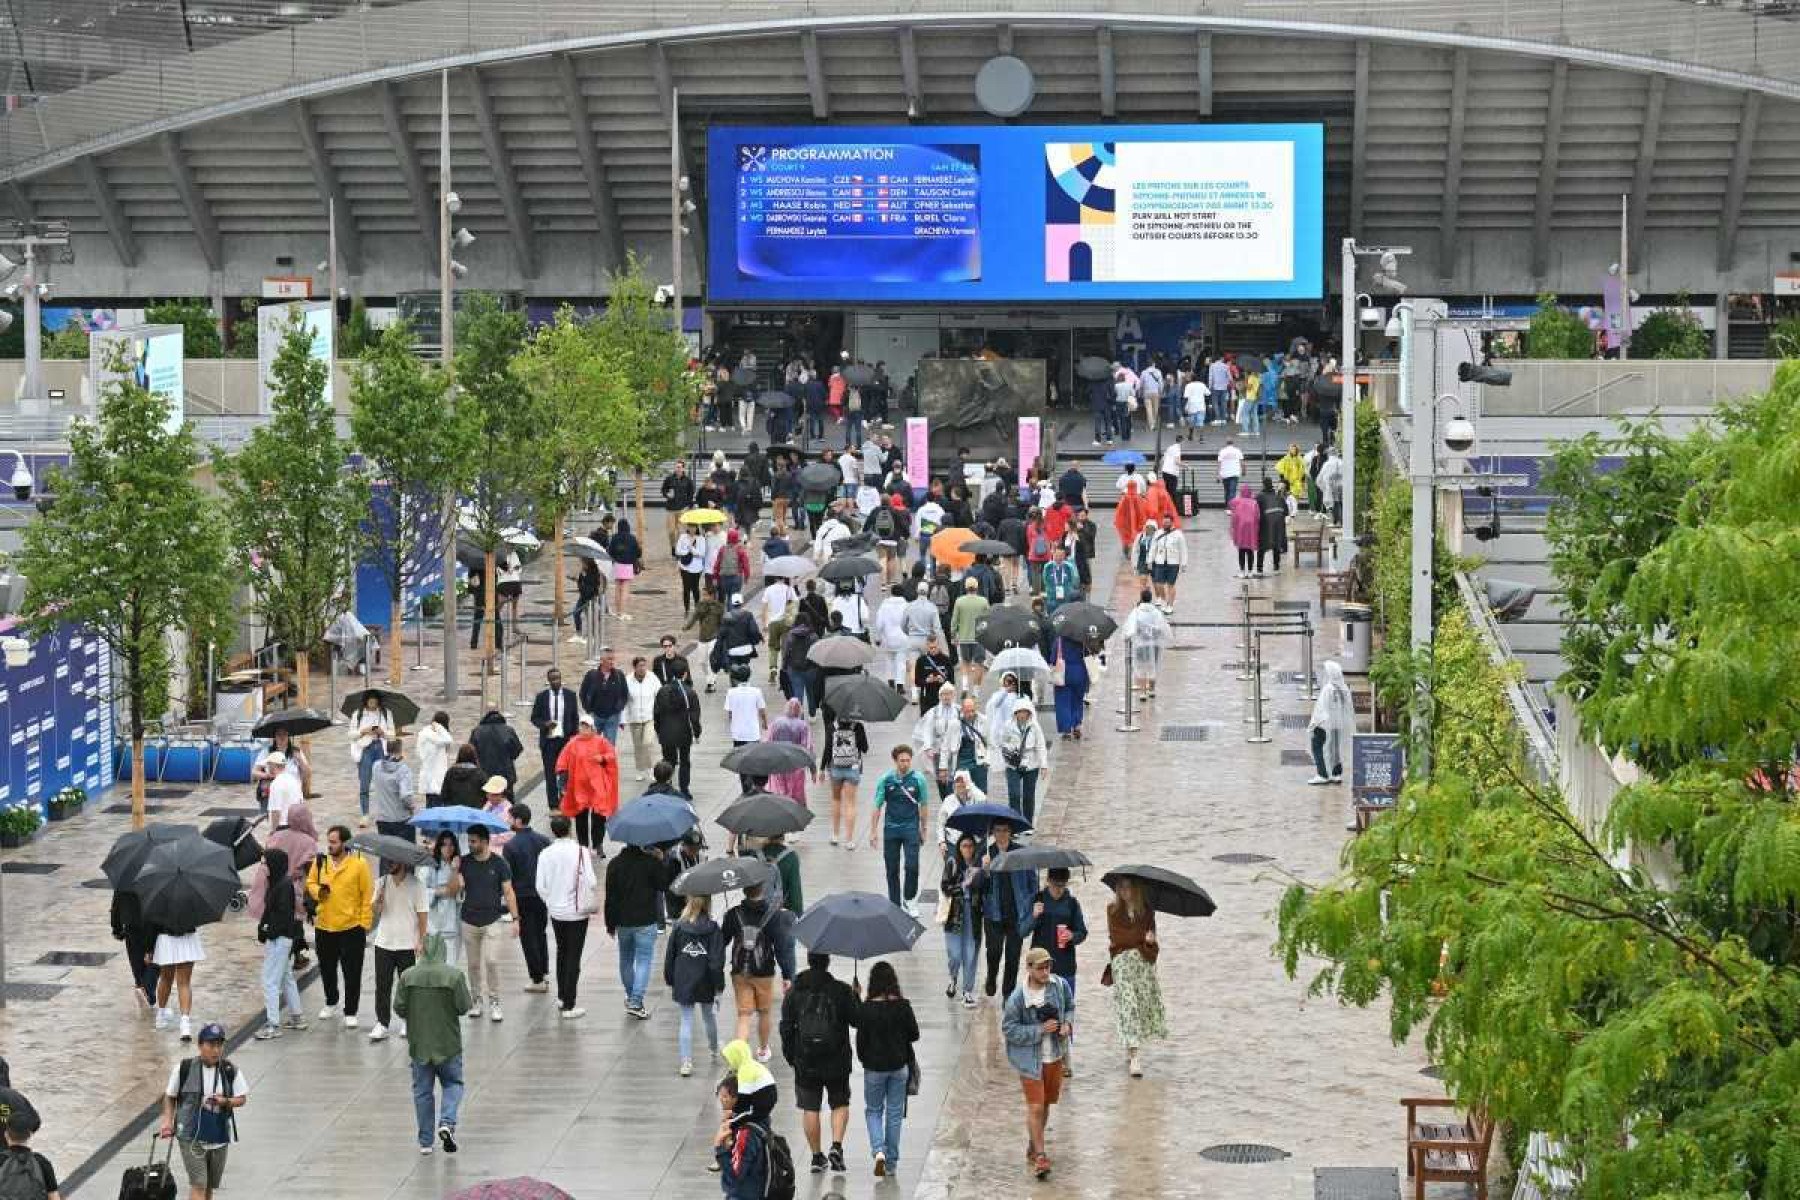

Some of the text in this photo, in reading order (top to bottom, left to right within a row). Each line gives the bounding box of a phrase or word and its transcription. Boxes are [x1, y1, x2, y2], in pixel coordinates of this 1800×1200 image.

[771, 148, 894, 160] PROGRAMMATION
[1132, 212, 1216, 220] PLAY WILL NOT START
[1132, 222, 1146, 230] ON
[1238, 221, 1252, 229] THE
[1168, 232, 1202, 240] COURTS
